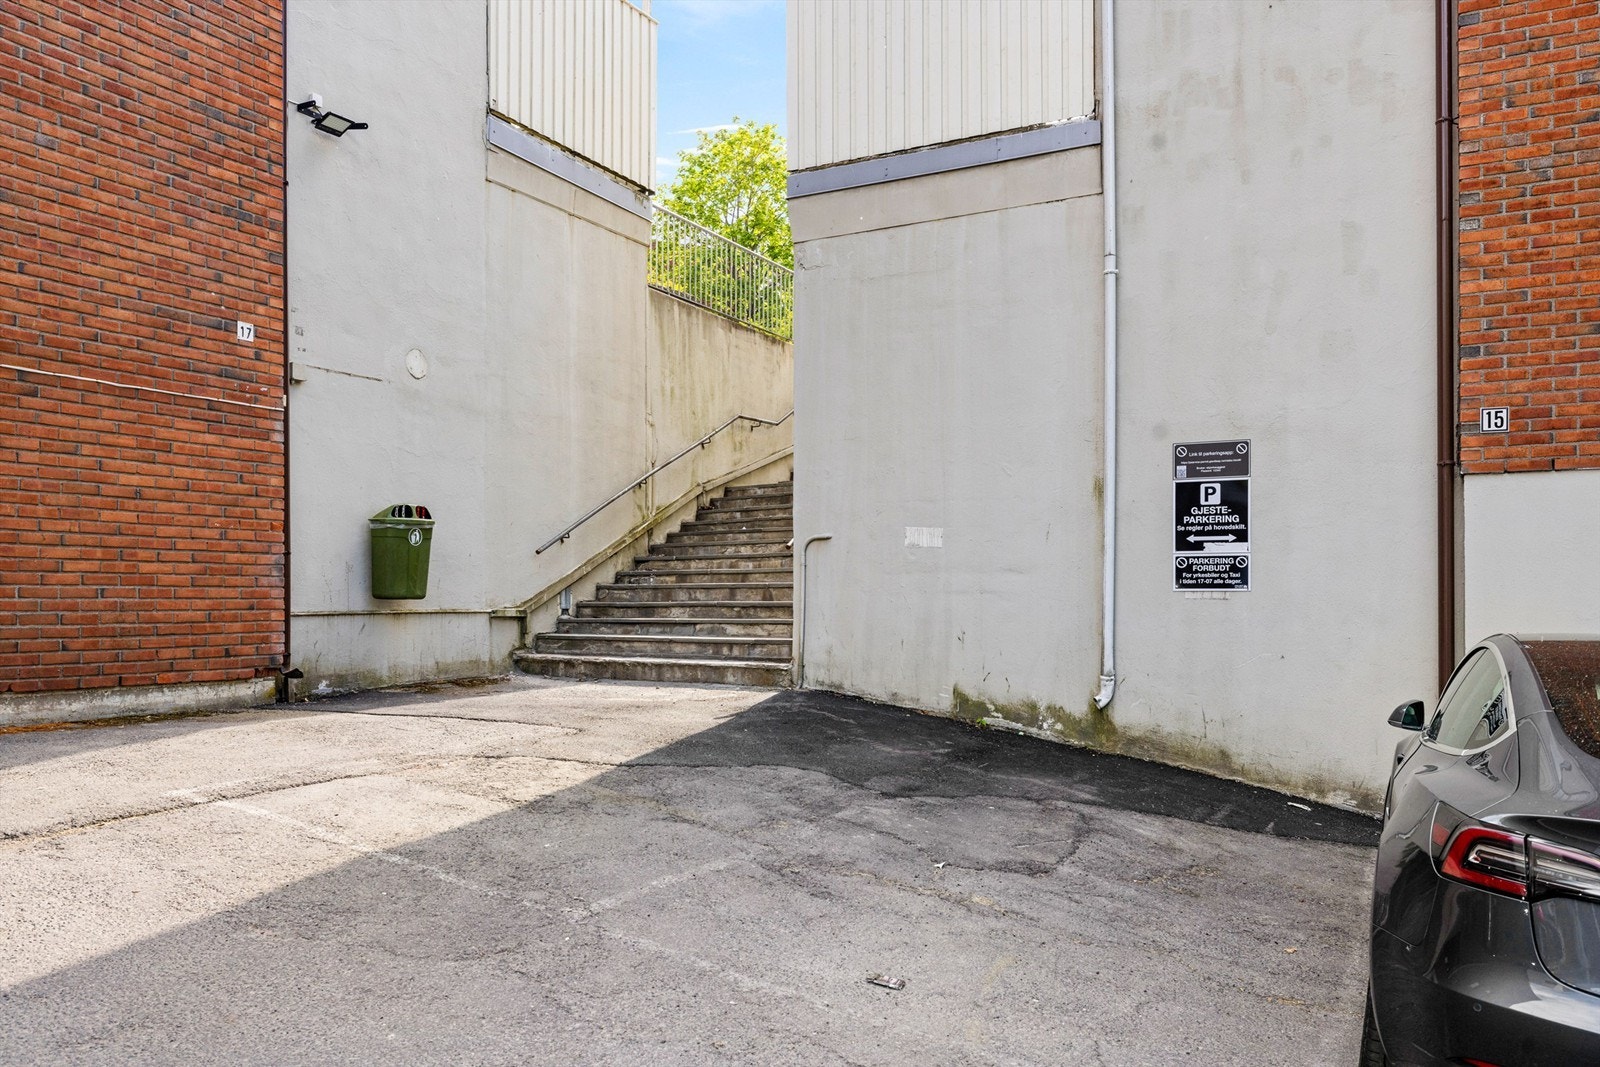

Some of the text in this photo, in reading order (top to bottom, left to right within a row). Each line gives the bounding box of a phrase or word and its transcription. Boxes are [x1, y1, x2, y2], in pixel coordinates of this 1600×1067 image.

[240, 326, 252, 339] 17
[1486, 411, 1504, 428] 15
[1204, 486, 1216, 502] P
[1191, 506, 1232, 514] GJESTE-
[1184, 515, 1240, 524] PARKERING
